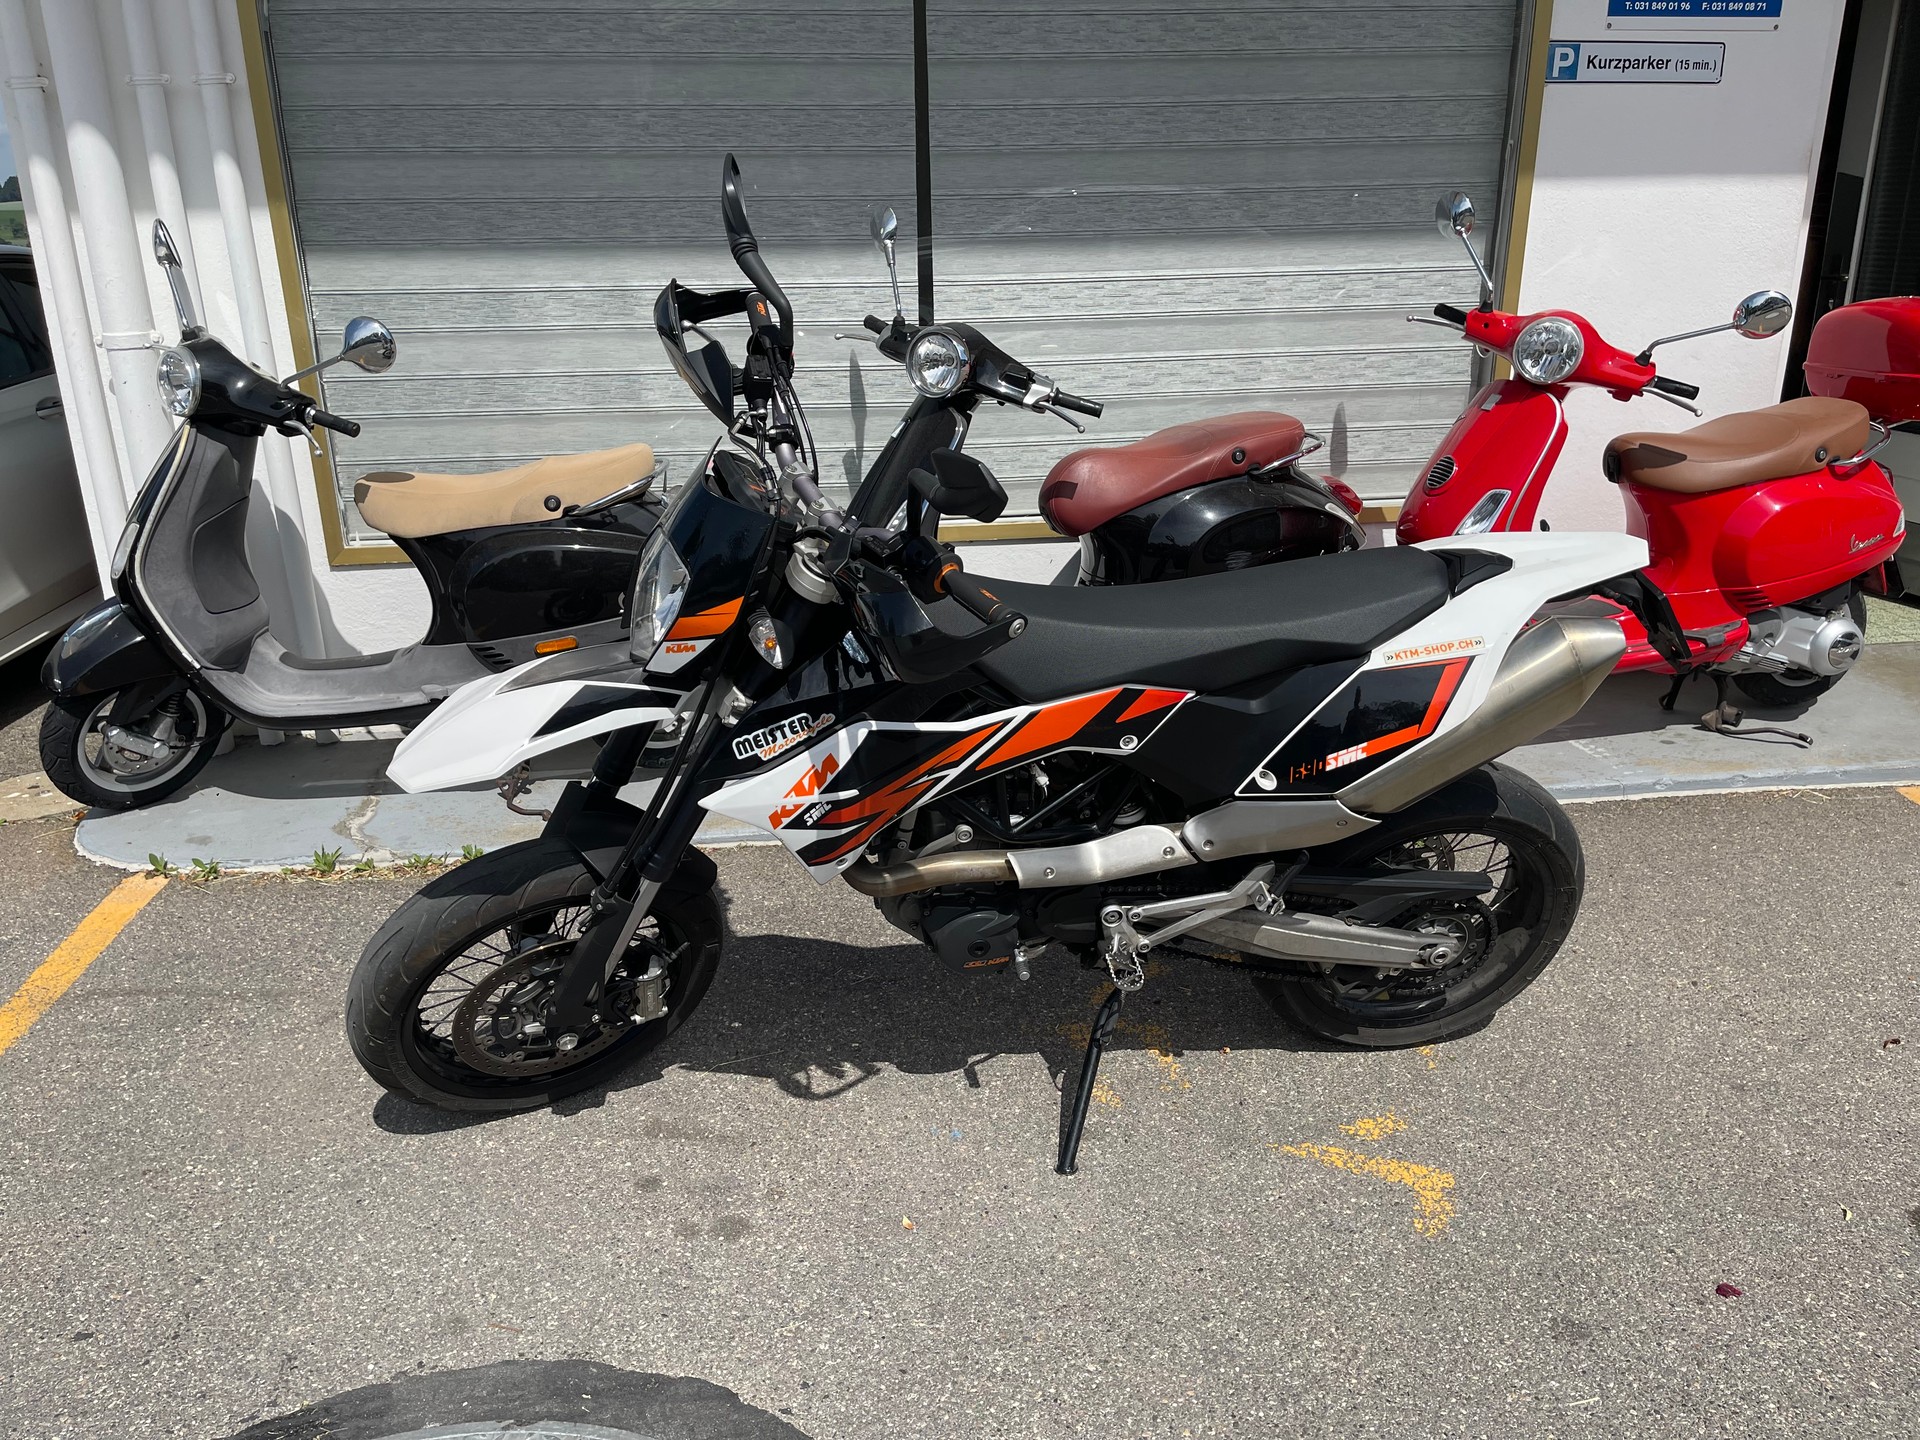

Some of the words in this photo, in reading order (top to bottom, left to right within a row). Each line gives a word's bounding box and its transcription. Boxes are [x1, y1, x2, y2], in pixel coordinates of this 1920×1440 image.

[1625, 2, 1633, 10] T:
[1634, 2, 1649, 10] 031
[1651, 2, 1667, 10] 849
[1668, 2, 1678, 10] 01
[1680, 2, 1691, 11] 96
[1702, 2, 1710, 11] F:
[1711, 2, 1726, 11] 031
[1728, 2, 1743, 11] 849
[1745, 2, 1755, 11] 08
[1757, 2, 1767, 11] 71
[1551, 47, 1575, 78] P
[1586, 55, 1672, 74] Kurzparker
[1674, 58, 1690, 72] (15
[1692, 59, 1717, 73] min.)
[665, 643, 696, 654] KTM
[1394, 639, 1475, 662] KTM-SHOP.CH
[735, 715, 813, 756] MEISTER
[760, 715, 834, 758] Motorcycle
[768, 753, 840, 830] KTM
